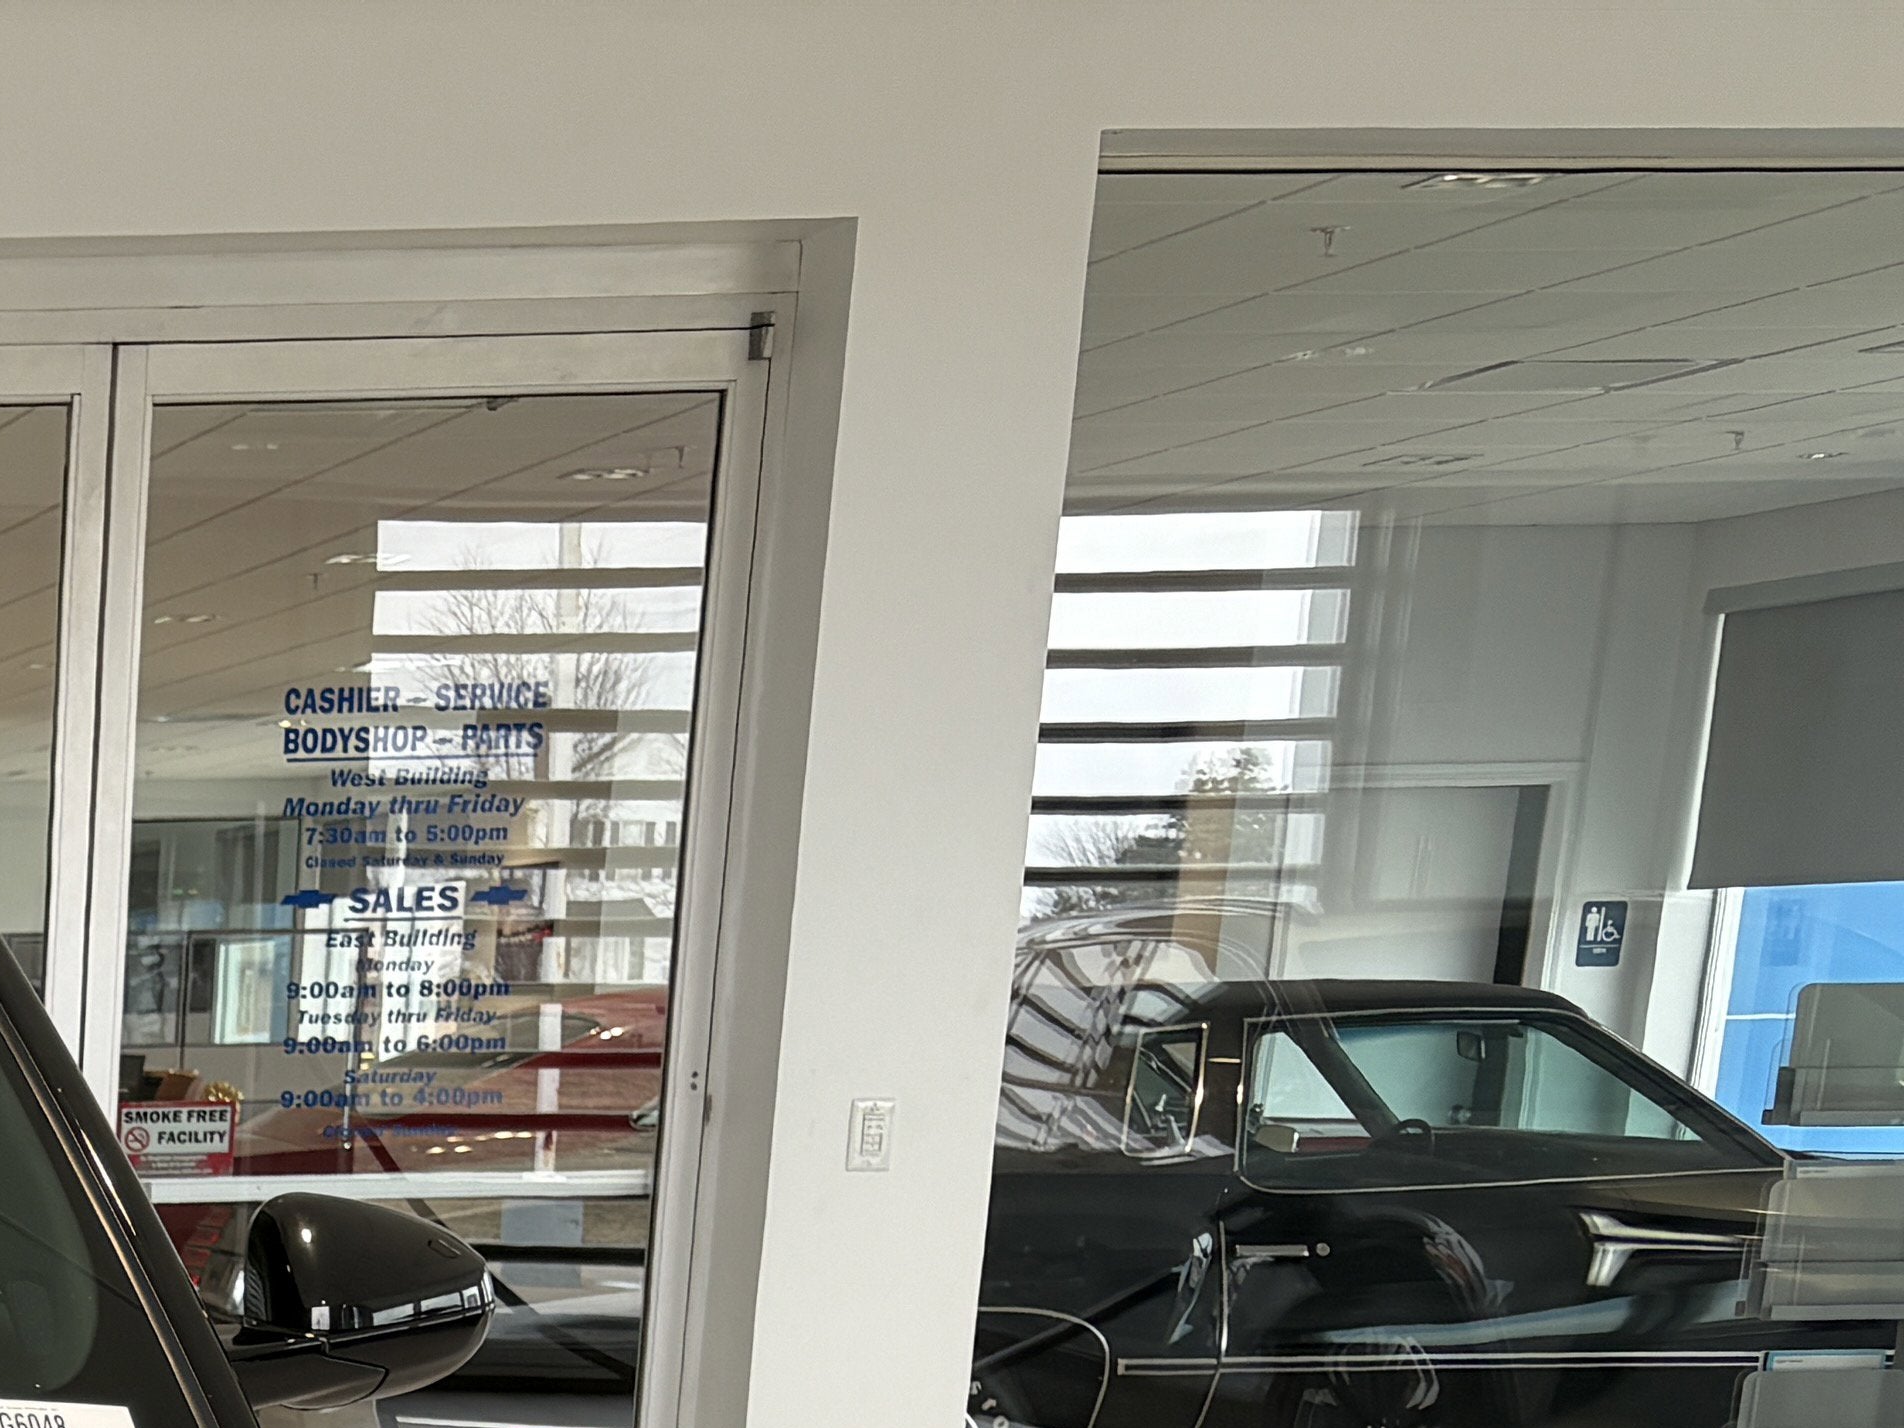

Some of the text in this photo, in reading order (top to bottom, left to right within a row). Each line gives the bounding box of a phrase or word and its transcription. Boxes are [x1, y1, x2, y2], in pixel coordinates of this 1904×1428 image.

[284, 680, 550, 715] CASHIER SERVICE
[283, 722, 543, 754] BODYSHOP PARTS
[331, 766, 489, 788] West Building
[283, 794, 525, 818] Monday thru Friday
[305, 824, 508, 845] 7:30am to 5:00pm
[363, 854, 427, 868] Saturday
[434, 854, 445, 865] &
[450, 853, 505, 866] Sunday
[349, 885, 459, 913] SALES
[326, 928, 477, 949] East Building
[356, 957, 434, 974] Monday
[286, 979, 510, 999] 9:00am to 8:00pm
[298, 1006, 496, 1026] Tuesday thru Friday
[283, 1034, 506, 1054] 9:00am to 6:00pm
[345, 1068, 436, 1085] Saturday
[280, 1087, 503, 1109] 9:00am to 4:00pm
[123, 1109, 228, 1124] SMOKE FREE
[157, 1130, 227, 1144] FACILITY
